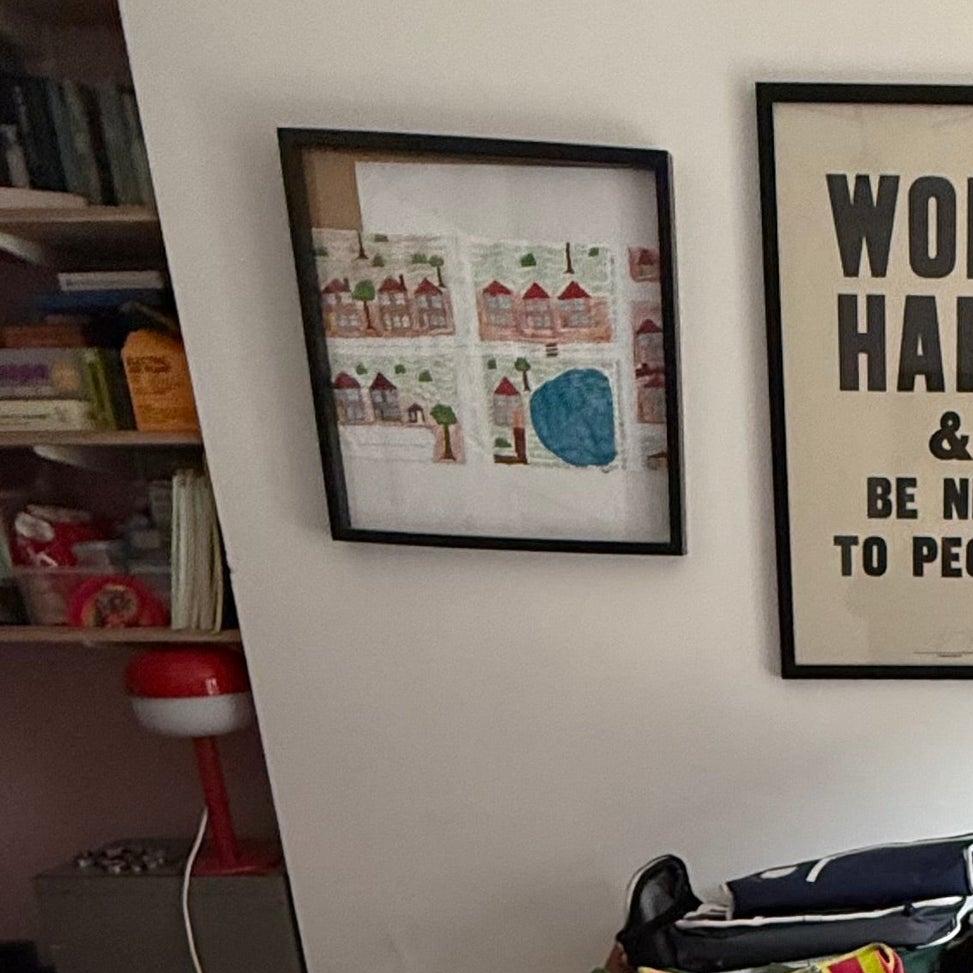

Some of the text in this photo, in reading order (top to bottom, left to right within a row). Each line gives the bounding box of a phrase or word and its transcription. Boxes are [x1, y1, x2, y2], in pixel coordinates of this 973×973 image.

[929, 411, 973, 461] &
[867, 477, 918, 519] BE
[833, 535, 887, 577] TO
